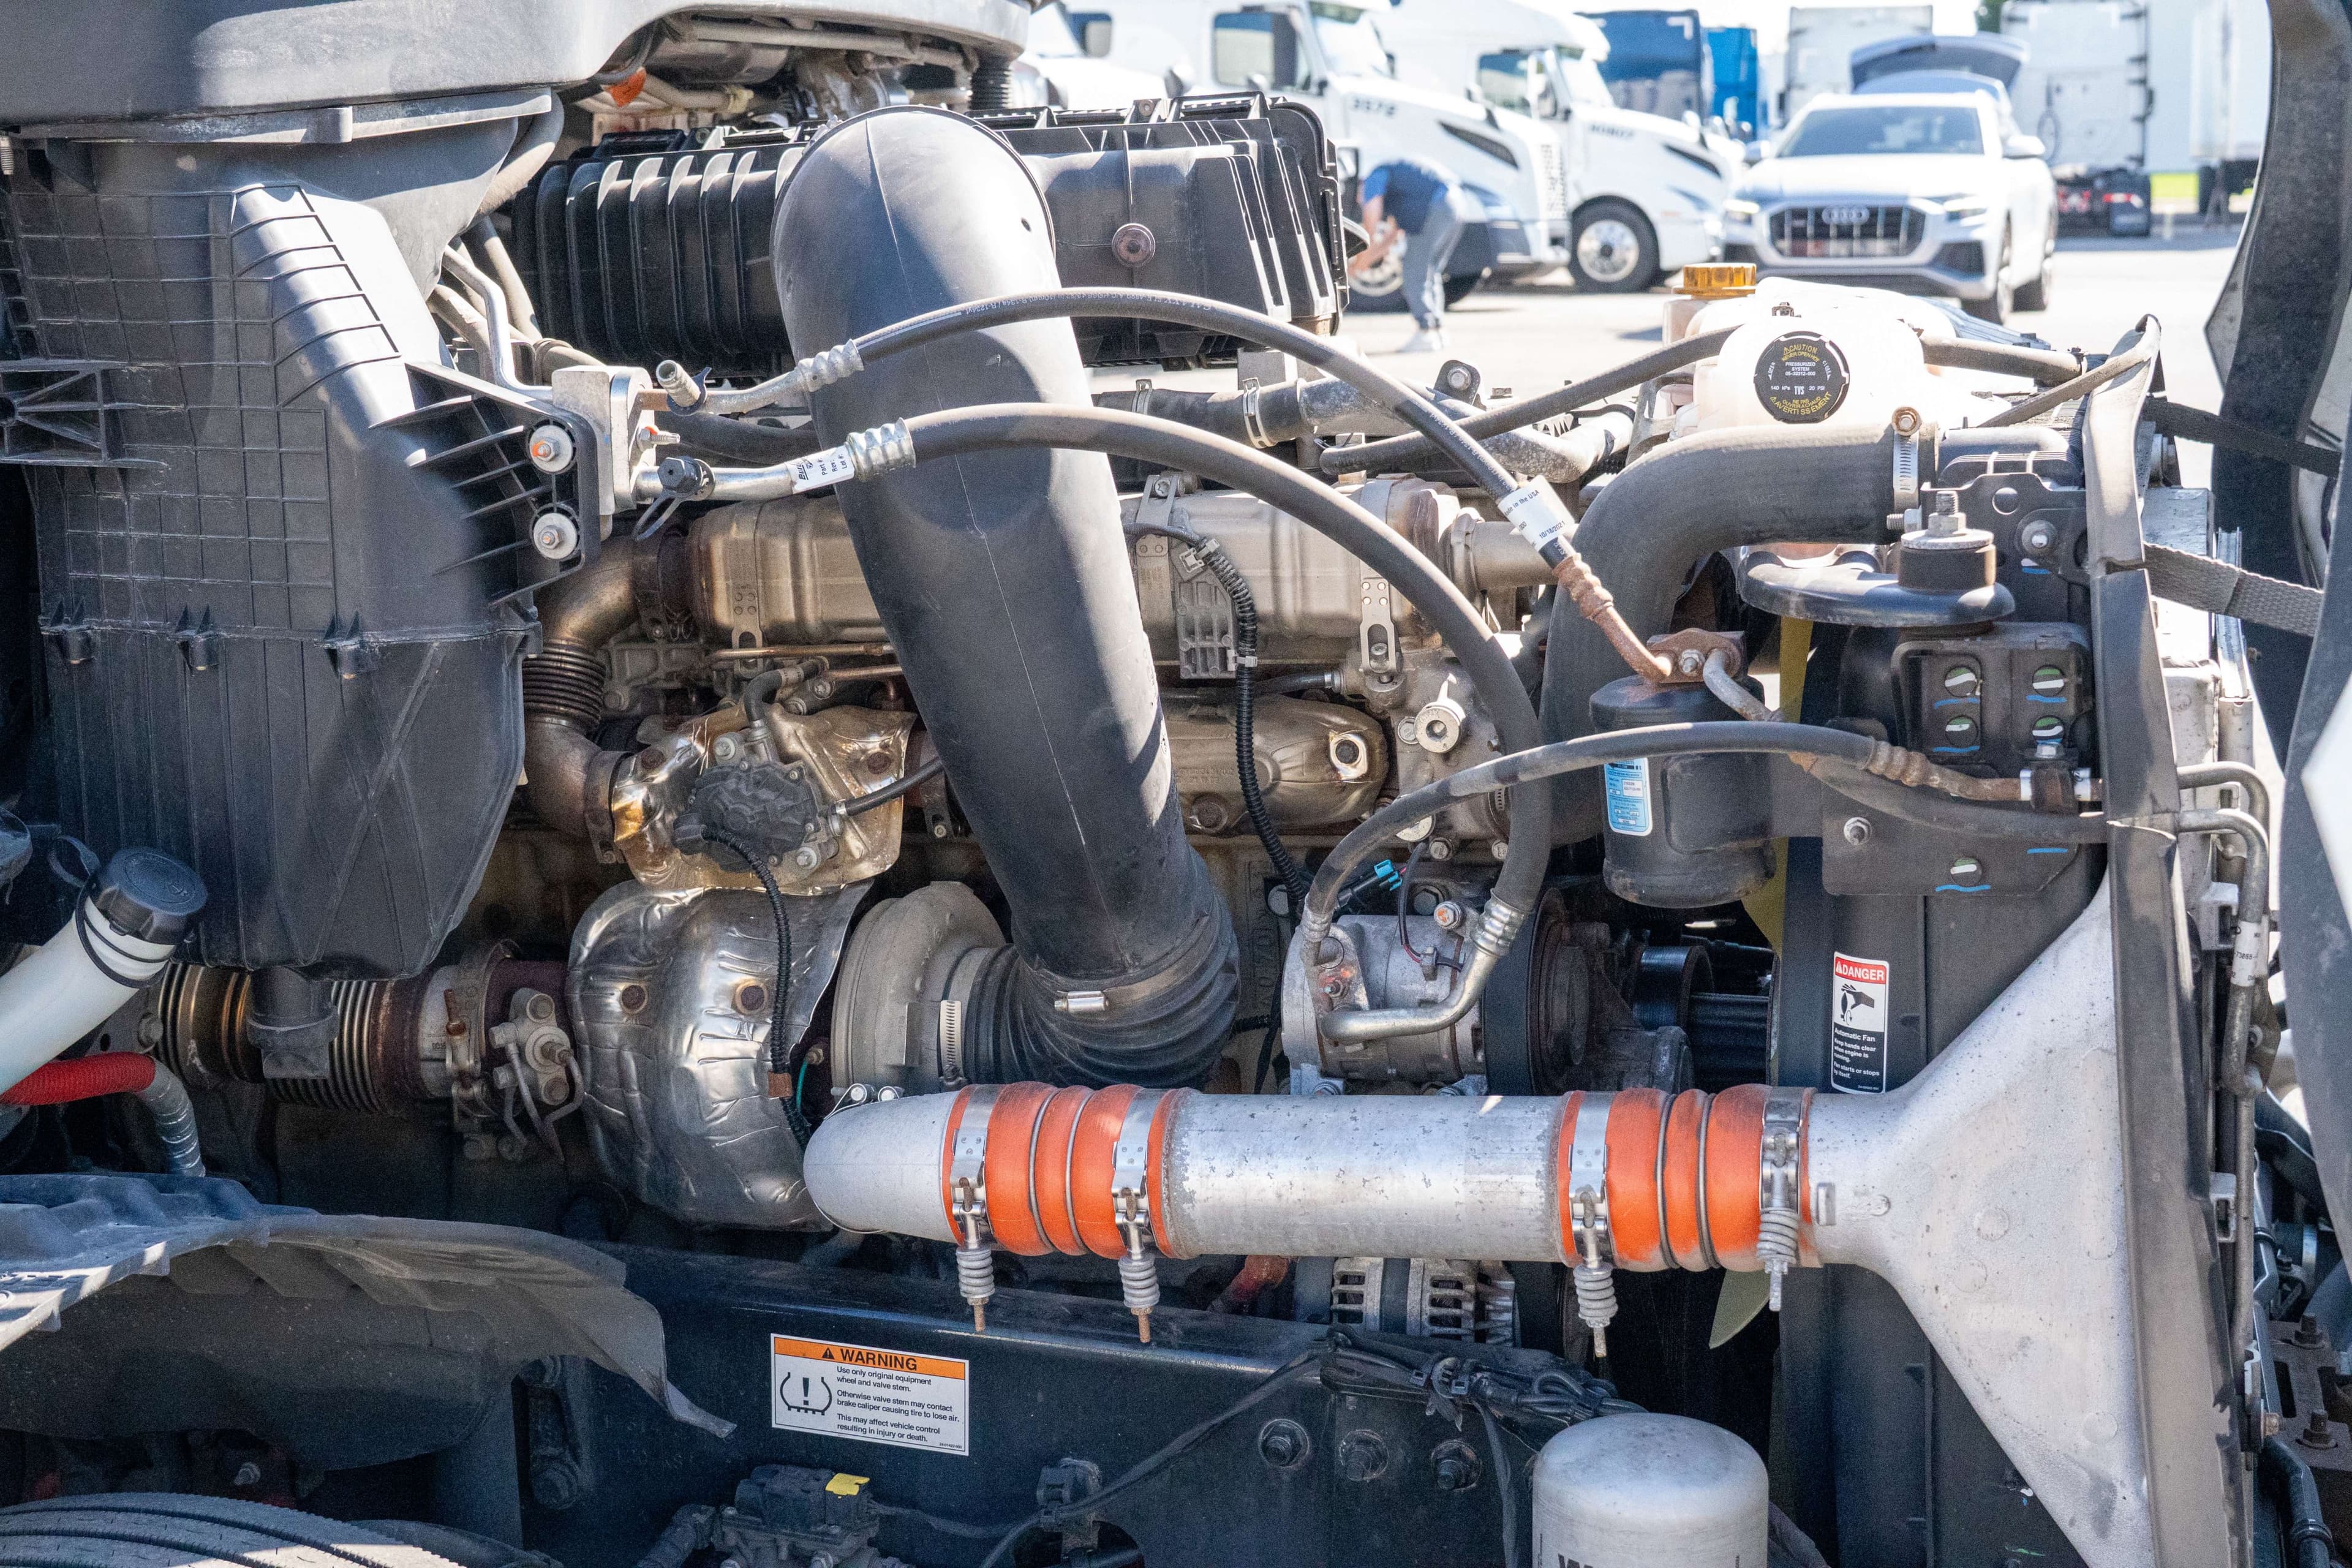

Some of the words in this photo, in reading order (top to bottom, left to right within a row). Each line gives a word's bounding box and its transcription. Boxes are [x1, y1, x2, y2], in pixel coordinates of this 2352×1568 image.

[966, 303, 997, 315] R-1234yf
[1789, 344, 1817, 354] CAUTION
[1782, 352, 1798, 361] NEVER
[1794, 386, 1804, 395] TVS
[1528, 490, 1539, 499] USA
[1842, 963, 1885, 981] DANGER
[1835, 1028, 1861, 1039] Automatic
[840, 1349, 917, 1371] WARNING
[851, 1369, 866, 1378] only
[868, 1370, 894, 1380] original
[895, 1374, 931, 1385] equipment
[892, 1383, 911, 1392] stem.
[837, 1390, 871, 1401] Otherwise
[873, 1395, 891, 1403] valve
[892, 1397, 909, 1406] stem
[911, 1401, 925, 1411] may
[927, 1403, 952, 1412] contact
[837, 1399, 856, 1408] brake
[858, 1401, 881, 1412] caliper
[882, 1405, 909, 1417] causing
[837, 1423, 867, 1434] resulting
[876, 1428, 895, 1439] injury
[907, 1433, 927, 1442] death.
[853, 1417, 868, 1426] may
[869, 1418, 888, 1427] affect
[890, 1420, 914, 1431] vehicle
[915, 1425, 940, 1434] control
